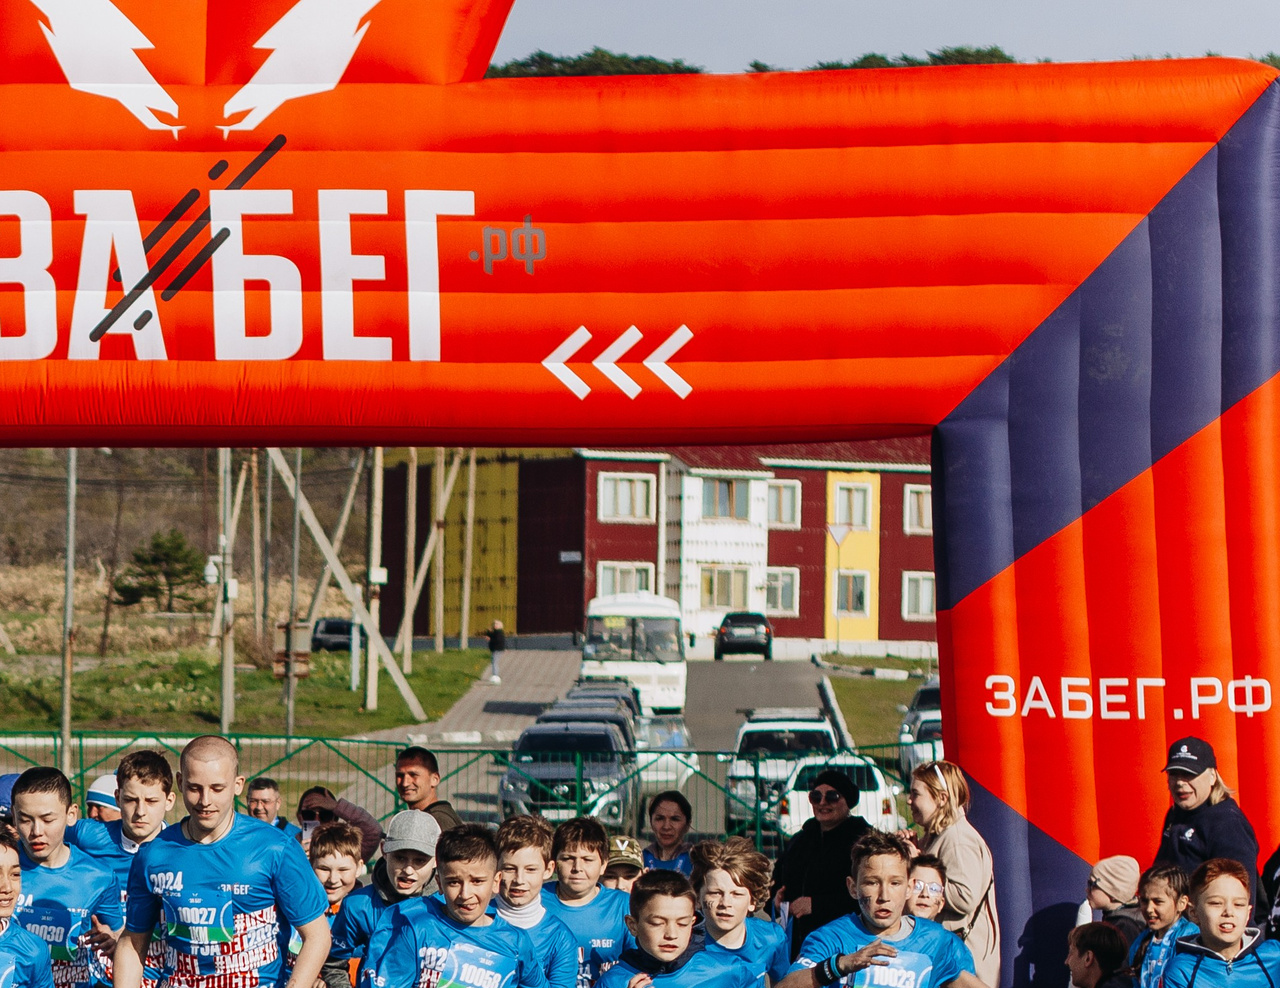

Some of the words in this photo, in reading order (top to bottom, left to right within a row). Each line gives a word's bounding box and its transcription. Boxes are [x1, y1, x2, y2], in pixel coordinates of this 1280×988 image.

[985, 674, 1272, 720] ЗАБЕГ.РФ
[150, 871, 184, 894] 2024
[178, 906, 217, 926] 10027
[25, 922, 65, 943] 10030
[214, 940, 279, 974] #МОМЕНТ
